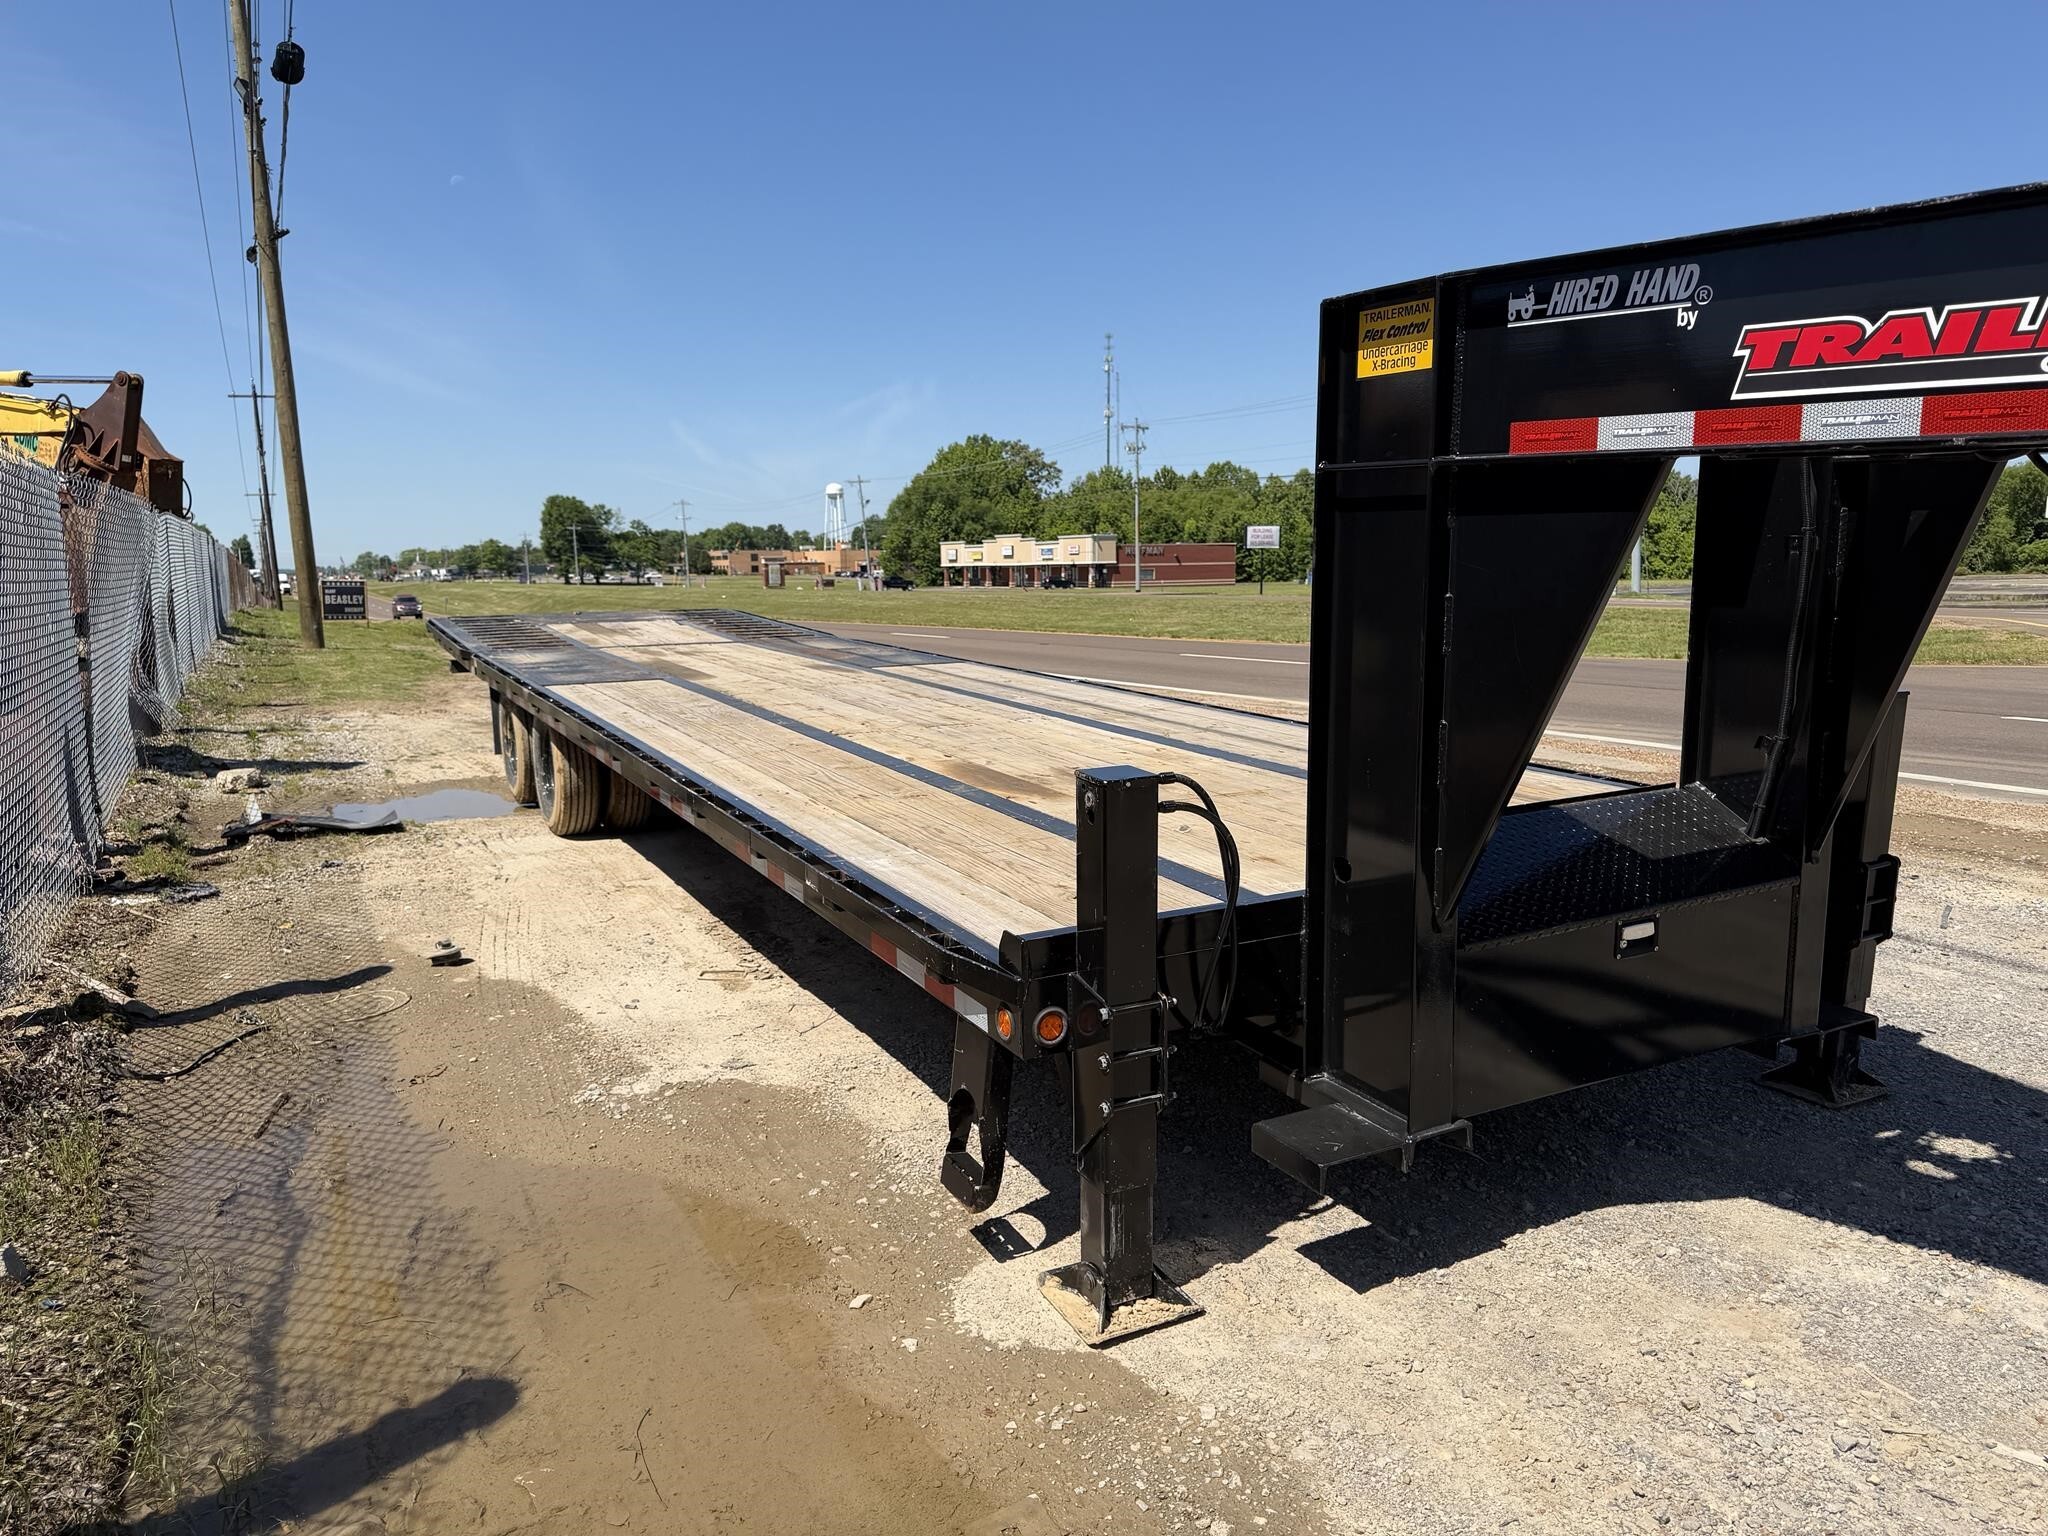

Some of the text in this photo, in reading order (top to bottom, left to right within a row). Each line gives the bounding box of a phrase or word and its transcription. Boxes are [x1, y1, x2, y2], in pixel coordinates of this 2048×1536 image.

[1546, 274, 1619, 316] HIRED
[1676, 308, 1699, 330] by
[1362, 318, 1431, 343] Flex Control
[1743, 304, 2048, 370] TRAIL
[1362, 340, 1429, 360] Undercarriage
[1372, 355, 1416, 372] X-Bracing
[1821, 413, 1901, 424] TRAILERMAN
[1612, 426, 1677, 436] TRAILERMAN
[324, 594, 364, 604] BEASLEY
